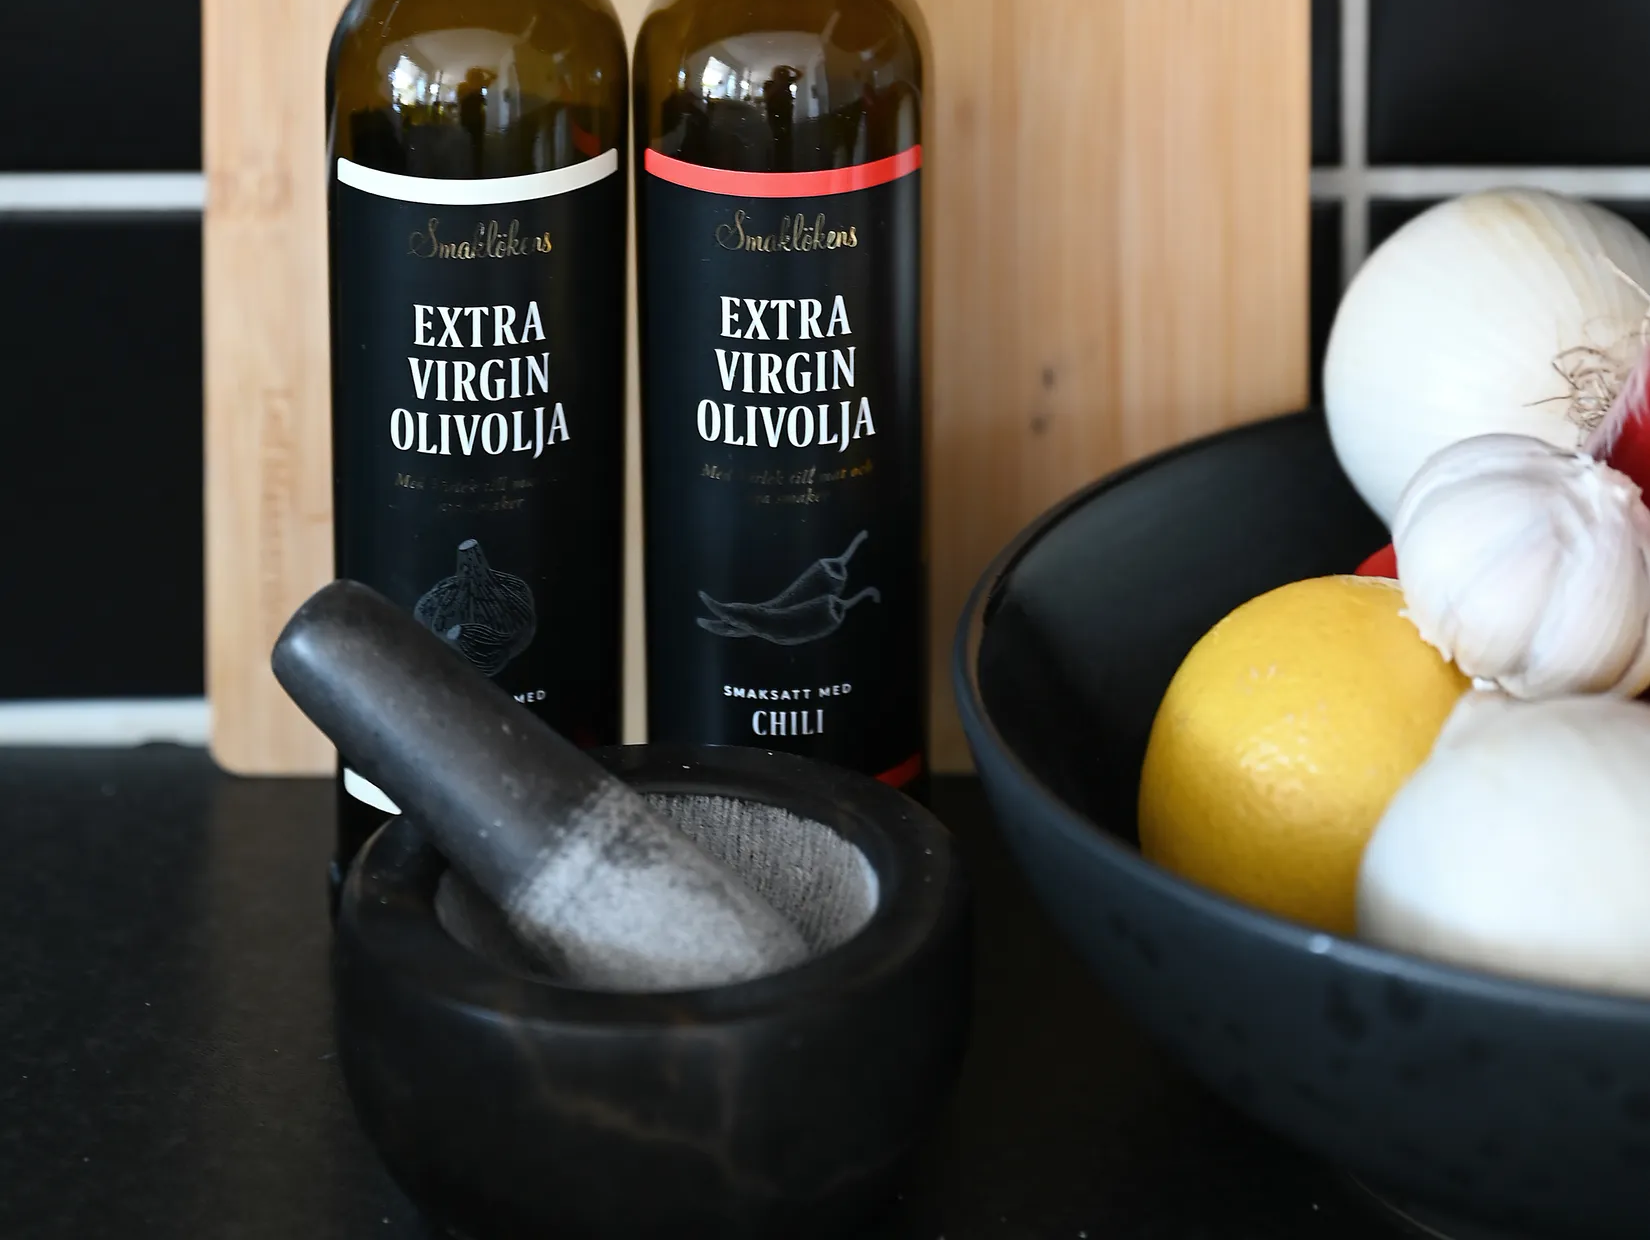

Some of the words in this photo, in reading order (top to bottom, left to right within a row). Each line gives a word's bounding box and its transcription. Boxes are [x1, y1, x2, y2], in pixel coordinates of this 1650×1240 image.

[715, 209, 858, 252] Smaklökens
[413, 300, 547, 348] EXTRA
[719, 294, 853, 341] EXTRA
[407, 352, 550, 402] VIRGIN
[713, 346, 857, 395] VIRGIN
[390, 402, 571, 459] OLIVOLJA
[696, 396, 876, 453] OLIVOLJA
[723, 685, 812, 701] SMAKSATT
[818, 682, 852, 698] MED
[751, 709, 824, 736] CHILI
